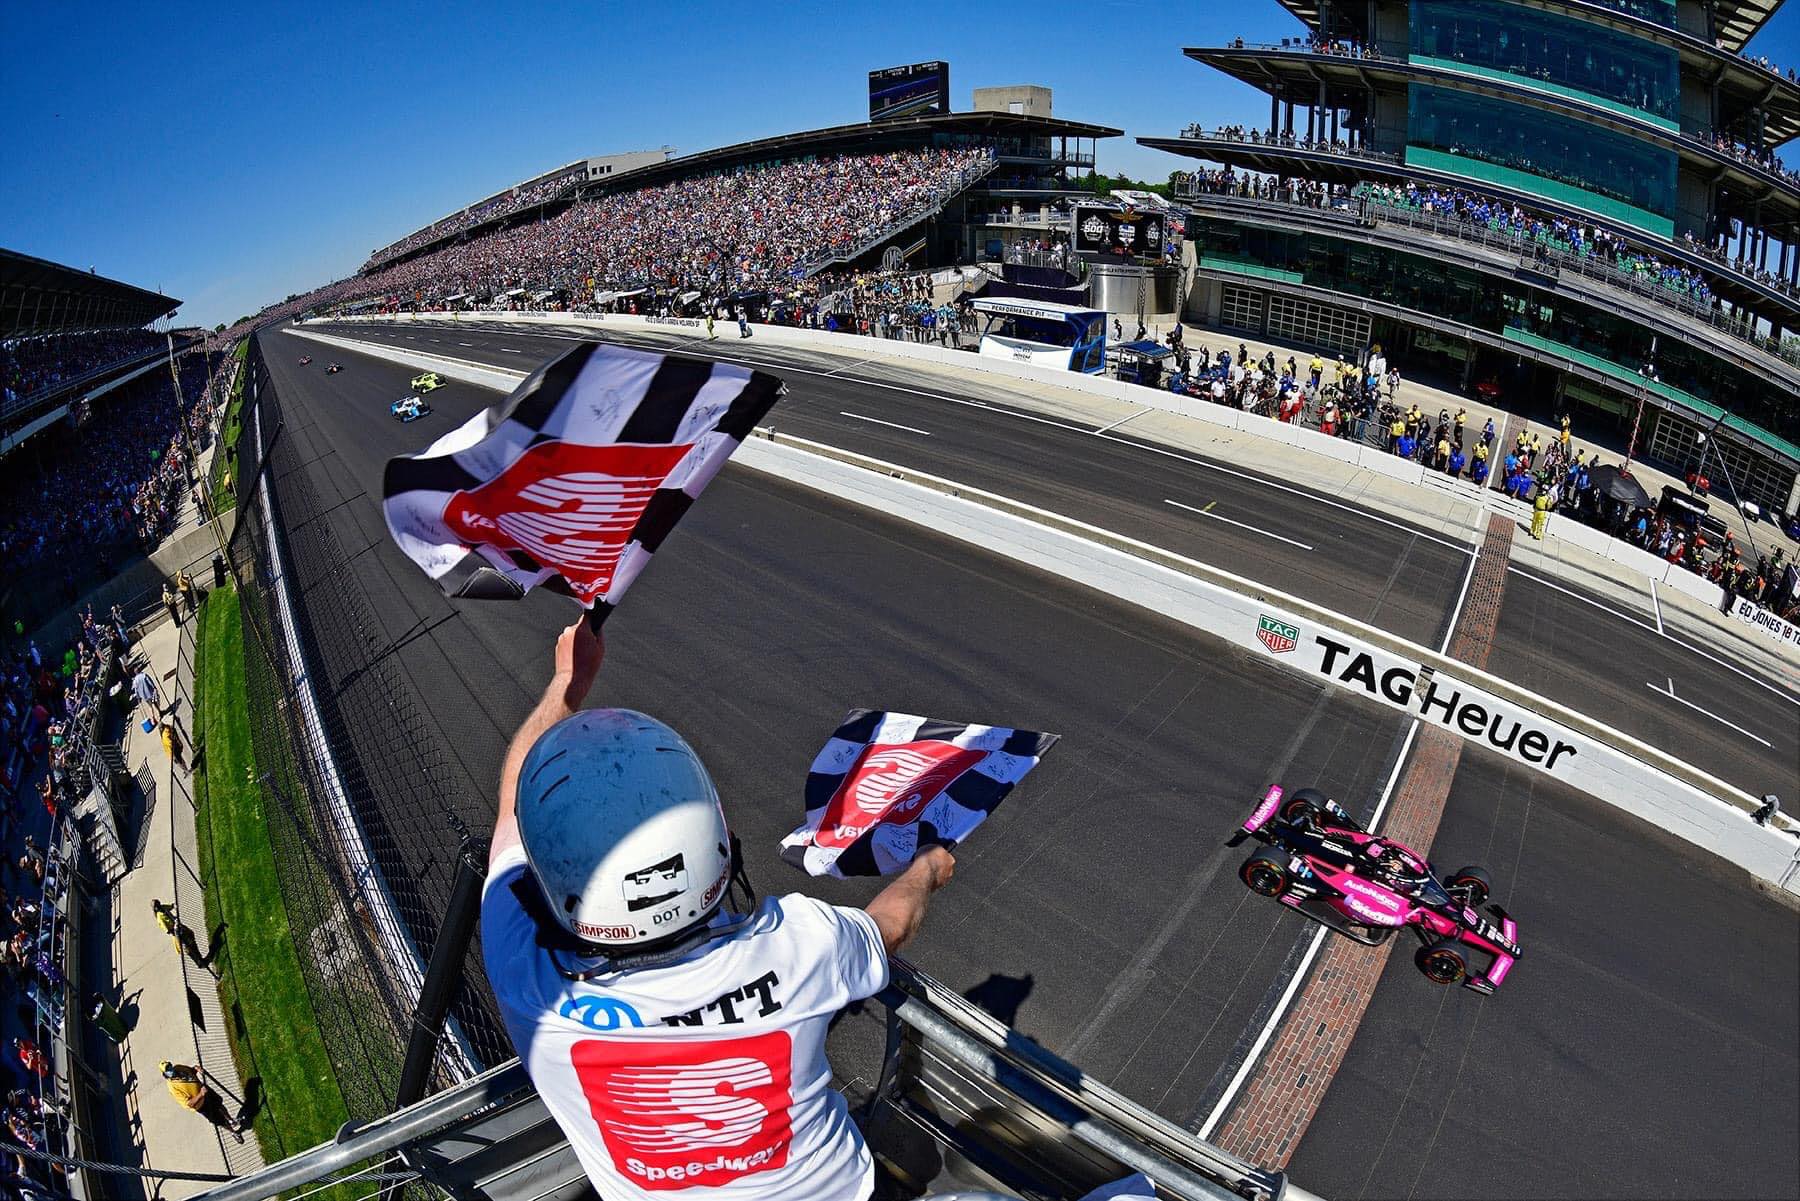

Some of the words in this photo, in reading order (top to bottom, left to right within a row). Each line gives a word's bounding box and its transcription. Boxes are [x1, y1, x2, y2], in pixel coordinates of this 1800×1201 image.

[991, 305, 1035, 317] PERFORMANCE
[1035, 310, 1045, 318] PIT
[1263, 618, 1296, 639] TAG
[1739, 602, 1753, 618] ED
[1752, 610, 1782, 633] JONES
[1782, 625, 1793, 639] 18
[1259, 630, 1294, 650] HEUER
[1315, 635, 1418, 706] TAG
[1419, 681, 1578, 770] Heuer
[652, 905, 681, 925] DOT
[574, 921, 630, 939] SIMPSON
[626, 1140, 784, 1181] Speedway
